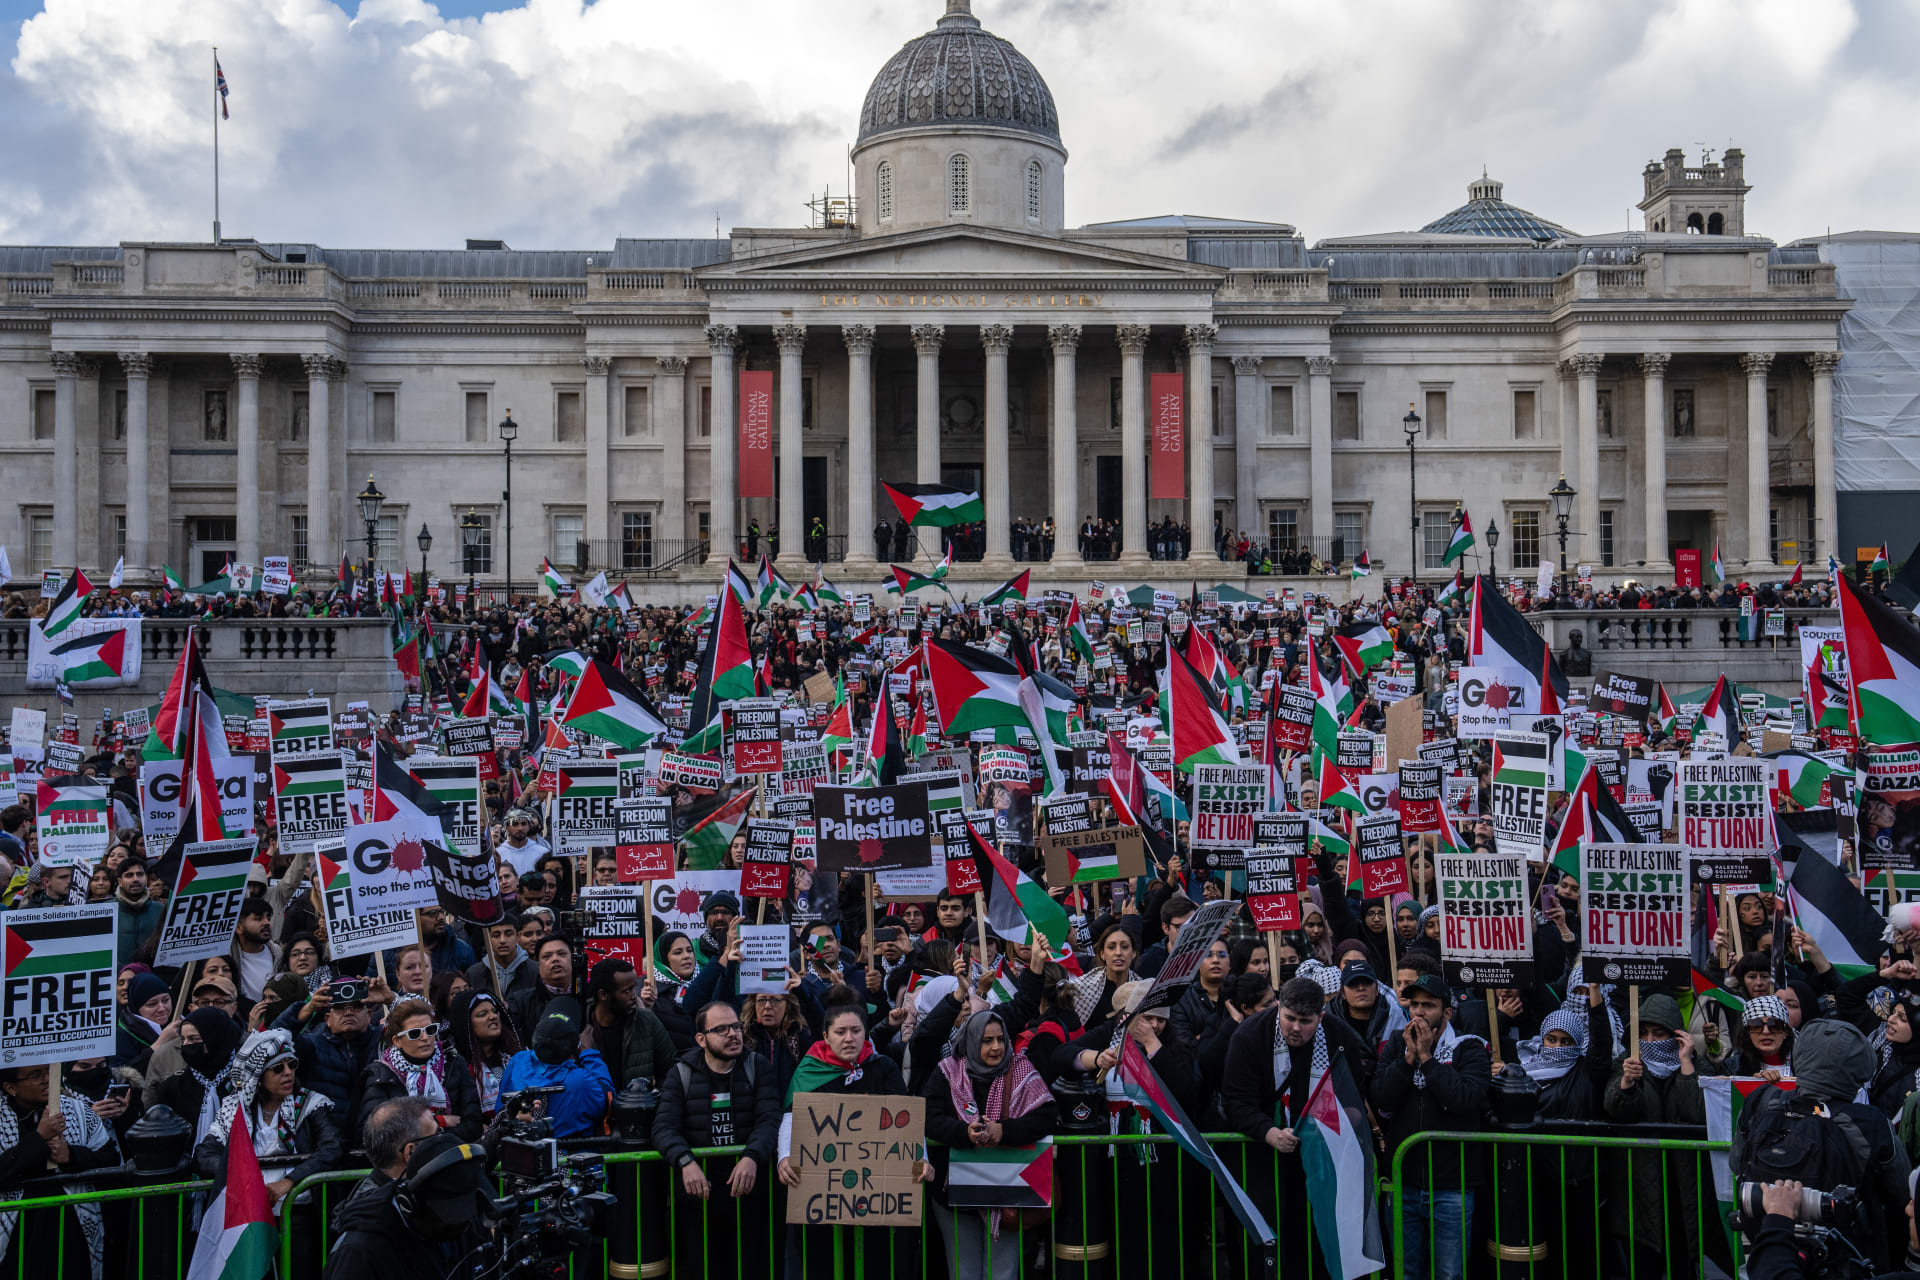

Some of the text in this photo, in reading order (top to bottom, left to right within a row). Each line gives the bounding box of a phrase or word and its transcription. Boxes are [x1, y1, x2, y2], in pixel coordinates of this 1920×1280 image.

[821, 294, 1106, 307] THE NATIONAL GALLERY
[748, 390, 758, 449] NATIONAL
[758, 391, 768, 450] GALLERY
[1160, 393, 1170, 452] NATIONAL
[1170, 394, 1181, 452] GALLERY
[1802, 631, 1843, 639] COUNTE
[1609, 674, 1637, 691] Free
[1282, 694, 1315, 707] FREEDOM
[1594, 683, 1649, 706] Palestine
[737, 711, 776, 723] FREEDOM
[1277, 709, 1313, 726] PALESTINE
[1462, 715, 1497, 726] Stop the
[448, 725, 486, 741] FREEDOM
[736, 728, 779, 740] PALESTINE
[794, 728, 817, 738] Free
[1281, 723, 1306, 736] الحرية
[272, 736, 331, 753] FREE
[449, 740, 492, 756] PALESTINE
[744, 744, 772, 756] الحرية
[794, 744, 824, 759] PALESTINE
[1340, 741, 1370, 752] FREEDOM
[50, 748, 80, 761] FREEDOM
[664, 753, 720, 770] STOP KILLING
[741, 755, 777, 768] لفلسطين
[981, 751, 1026, 762] STOP KILLING
[1087, 751, 1120, 765] Free
[1143, 751, 1170, 760] FREEDOM
[1338, 755, 1371, 767] PALESTINE
[1423, 746, 1455, 761] FREEDOM
[1869, 753, 1919, 764] KILLING
[47, 759, 79, 772] PALESTINE
[662, 762, 720, 778] THE CHILDREN
[783, 756, 826, 771] EXIST!
[1868, 764, 1920, 775] HILDREN
[661, 771, 717, 788] IN GAZA
[782, 767, 826, 781] RESIST!
[982, 769, 1028, 783] IN GAZA
[1199, 767, 1265, 784] FREE PALESTINE
[1402, 769, 1438, 781] FREEDOM
[1684, 765, 1763, 783] FREE PALESTINE
[1865, 775, 1920, 791] GAZA
[1199, 785, 1265, 801] EXIST!
[1400, 787, 1440, 799] PALESTINE
[1684, 784, 1764, 802] EXIST!
[278, 793, 347, 821] FREE
[559, 798, 616, 819] FREE
[777, 801, 810, 814] FREEDOM
[843, 793, 895, 816] Free
[1199, 801, 1265, 814] RESIST!
[1406, 803, 1434, 815] الحرية
[1493, 783, 1545, 820] FREE
[50, 809, 98, 825] FREE
[150, 810, 176, 821] Stop
[619, 808, 666, 823] FREEDOM
[1048, 802, 1086, 819] FREEDOM
[1684, 803, 1764, 818] RESIST!
[279, 818, 348, 834] PALESTINE
[559, 819, 616, 830] PALESTINE
[1049, 819, 1090, 835] PALESTINE
[1404, 813, 1438, 826] لفلسطين
[41, 824, 107, 837] PALESTINE
[618, 828, 670, 843] PALESTINE
[751, 829, 789, 844] FREEDOM
[820, 816, 925, 841] Palestine
[1258, 824, 1304, 837] FREEDOM
[1362, 824, 1398, 842] FREEDOM
[1685, 817, 1764, 849] RETURN!
[1052, 827, 1140, 848] FREE PALESTINE
[628, 847, 662, 861] الحرية
[747, 848, 789, 863] PALESTINE
[1362, 845, 1402, 862] PALESTINE
[1587, 850, 1682, 870] FREE PALESTINE
[447, 857, 496, 881] Free
[625, 859, 668, 876] لفلسطين
[751, 866, 780, 878] الحرية
[1248, 858, 1290, 873] FREEDOM
[1371, 862, 1397, 877] الحرية
[1441, 859, 1521, 878] FREE PALESTINE
[358, 882, 411, 897] Stop the
[746, 877, 782, 890] لفلسطين
[1249, 878, 1294, 894] PALESTINE
[1370, 875, 1402, 892] لفلسطين
[1442, 880, 1522, 899] EXIST!
[1588, 872, 1683, 893] EXIST!
[167, 889, 243, 927] FREE
[585, 899, 637, 914] FREEDOM
[1254, 897, 1286, 911] الحرية
[1444, 900, 1523, 916] RESIST!
[1588, 893, 1682, 912] RESIST!
[6, 907, 114, 923] Palestine Solidarity Campaign
[330, 908, 413, 935] PALESTINE
[163, 918, 236, 941] PALESTINE
[333, 935, 347, 944] END
[348, 928, 373, 942] ISRAELI
[374, 922, 414, 937] OCCUPATION
[673, 921, 688, 930] the
[1446, 916, 1525, 950] RETURN!
[1588, 910, 1683, 947] RETURN!
[161, 933, 231, 950] END ISRAELI OCCUPATION
[3, 970, 113, 1018] FREE
[2, 1007, 112, 1037] PALESTINE
[2, 1026, 111, 1048] END ISRAELI OCCUPATION
[19, 1043, 96, 1058] www.palestinecampaign.org
[808, 1103, 911, 1137] We DO
[800, 1141, 924, 1167] NOT STAND
[828, 1167, 873, 1192] FOR
[806, 1192, 913, 1225] GENOCIDE
